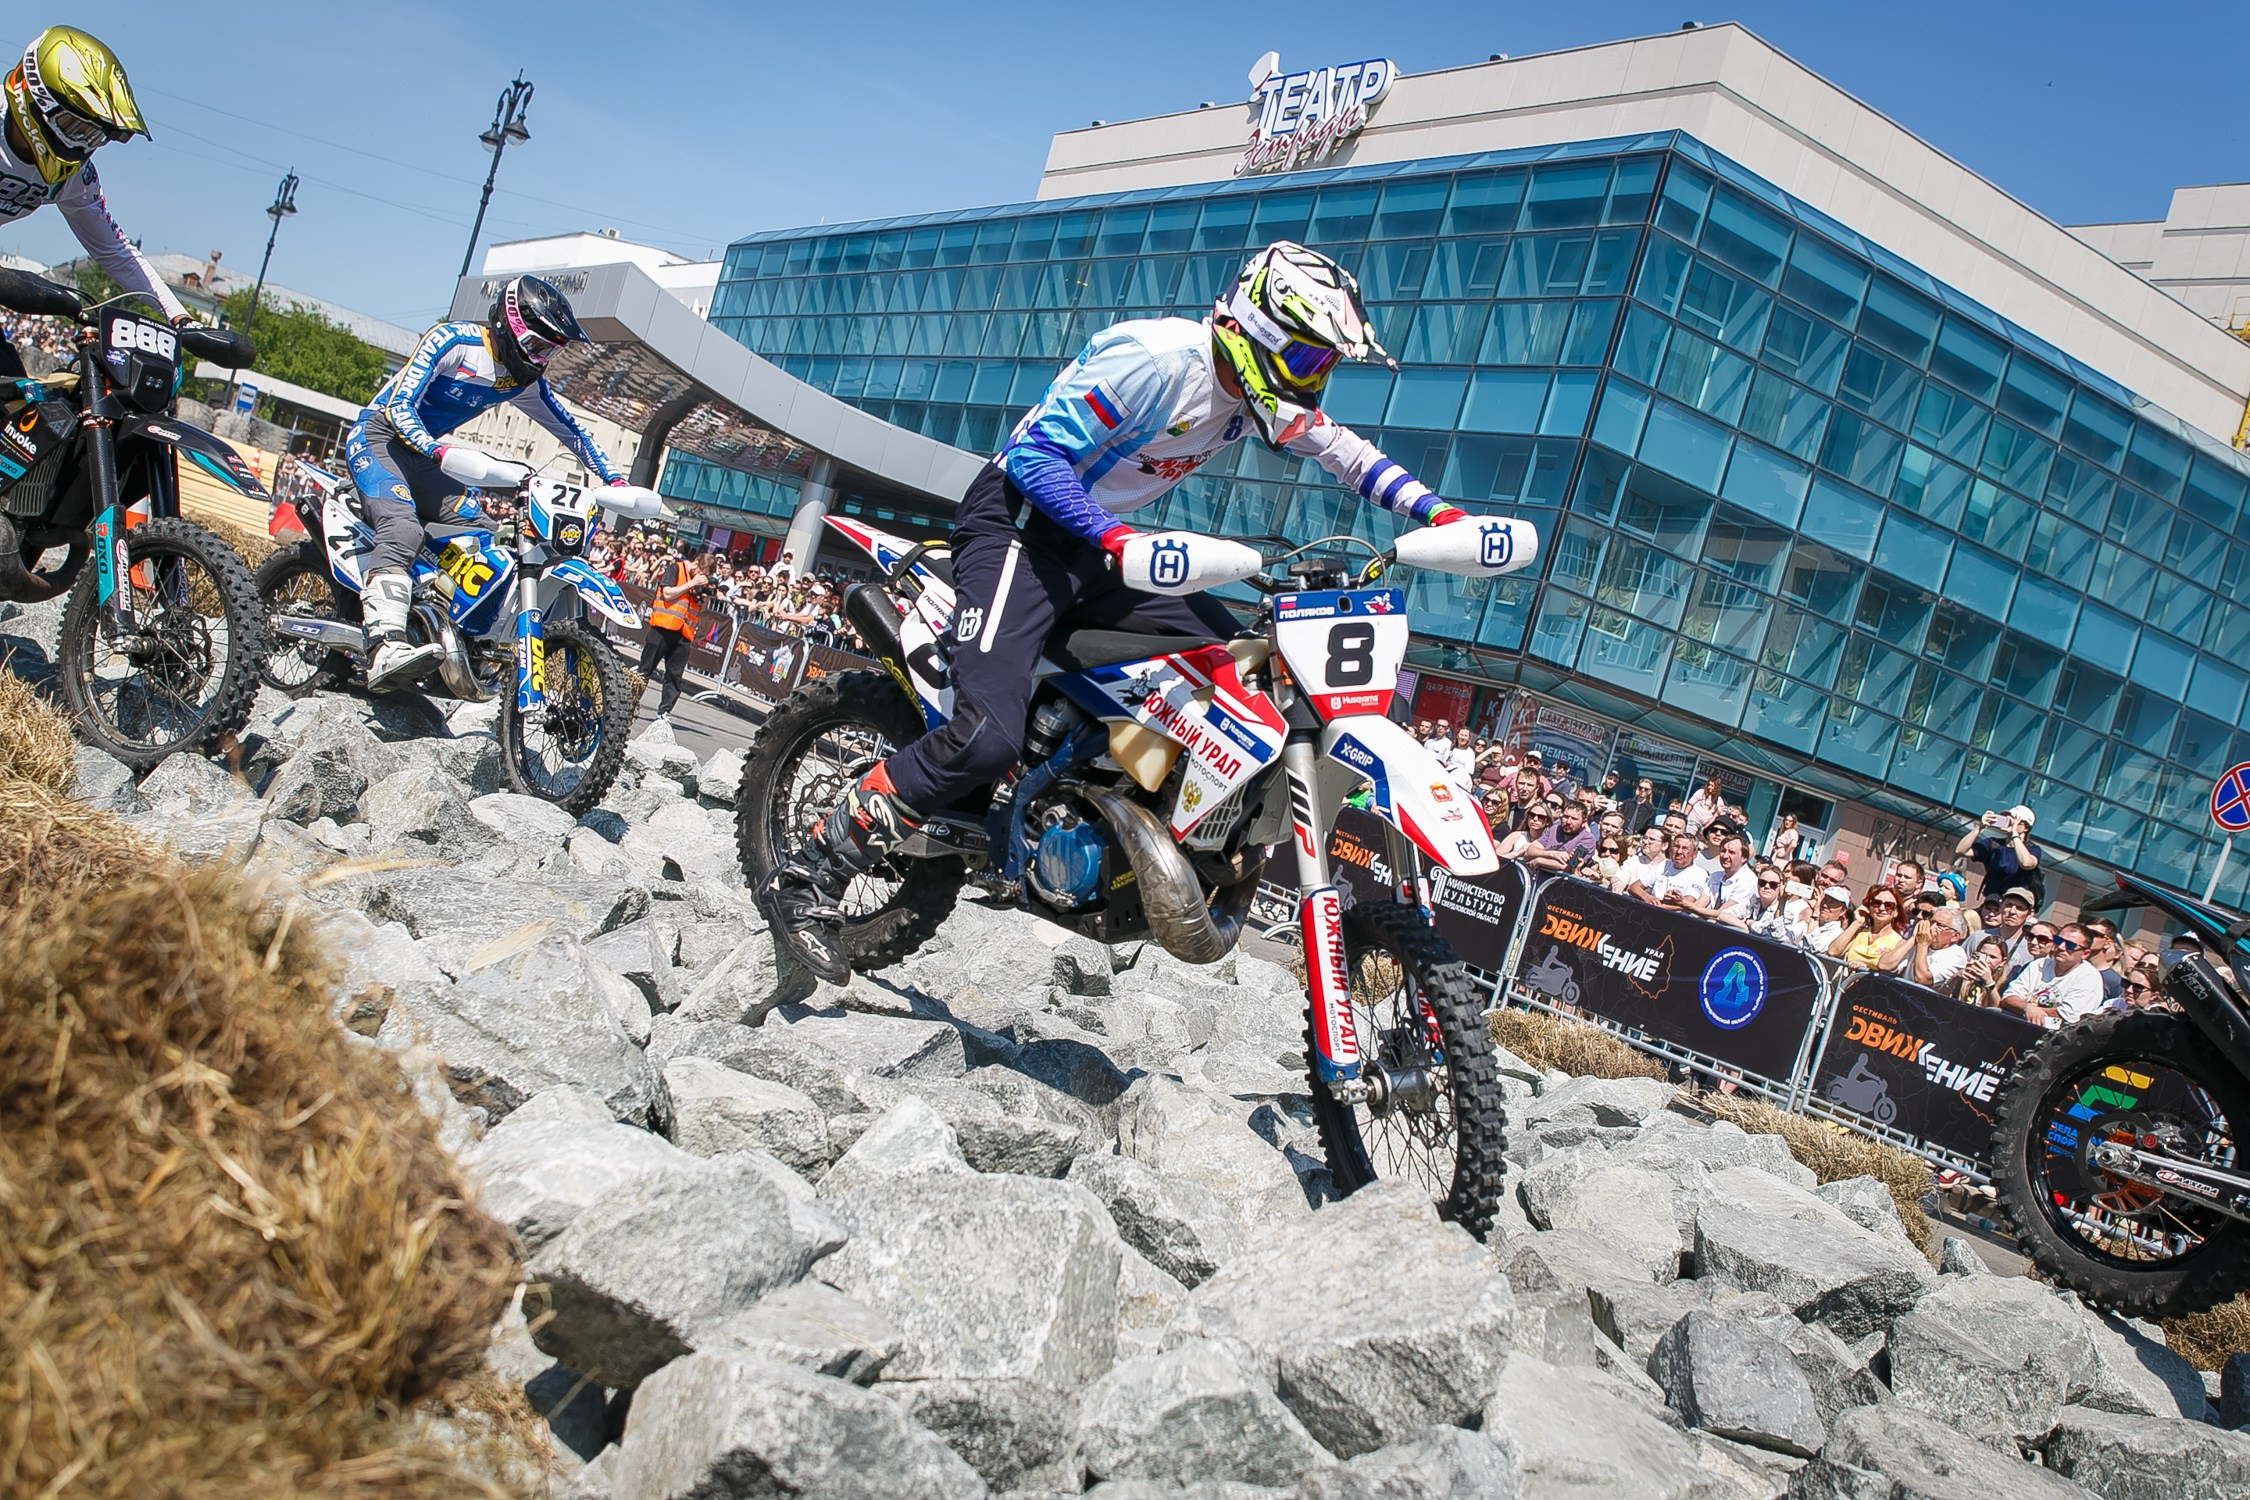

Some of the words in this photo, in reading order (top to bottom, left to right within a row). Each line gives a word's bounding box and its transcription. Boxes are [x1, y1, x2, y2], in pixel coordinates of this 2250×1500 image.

[1256, 58, 1392, 135] ТЕАТР
[13, 81, 47, 156] invoke
[111, 318, 177, 362] 888
[4, 420, 37, 455] invoke
[0, 459, 18, 474] OXO
[551, 483, 582, 509] 27
[559, 529, 583, 540] DRC
[421, 549, 441, 567] TEAM
[438, 542, 494, 597] DRC
[923, 594, 952, 621] ПОЛЯКО
[1279, 606, 1335, 619] ПОЛЯКОВ
[530, 636, 545, 695] DRC
[1325, 622, 1375, 688] 8
[1143, 690, 1205, 749] ЮЖНЫЙ
[1198, 737, 1242, 780] УРАЛ
[1340, 742, 1374, 767] X-GRIP
[1443, 888, 1502, 917] КУЛЬТУРЫ
[1446, 877, 1505, 905] МИНИСТЕРСТВО
[1441, 899, 1477, 918] СВЕРДЛОВСКОЙ
[1476, 912, 1500, 926] ОБЛАСТИ
[1546, 904, 1583, 921] ФЕСТИВАЛЬ
[1322, 895, 1350, 992] ЮЖНЫЙ
[1644, 946, 1665, 959] УРАЛ
[1328, 1002, 1341, 1053] МОТОСПОРТ
[1335, 997, 1358, 1055] УРАЛ
[1851, 1004, 1898, 1025] ФЕСТИВАЛЬ
[1979, 1060, 2006, 1075] УРАЛ
